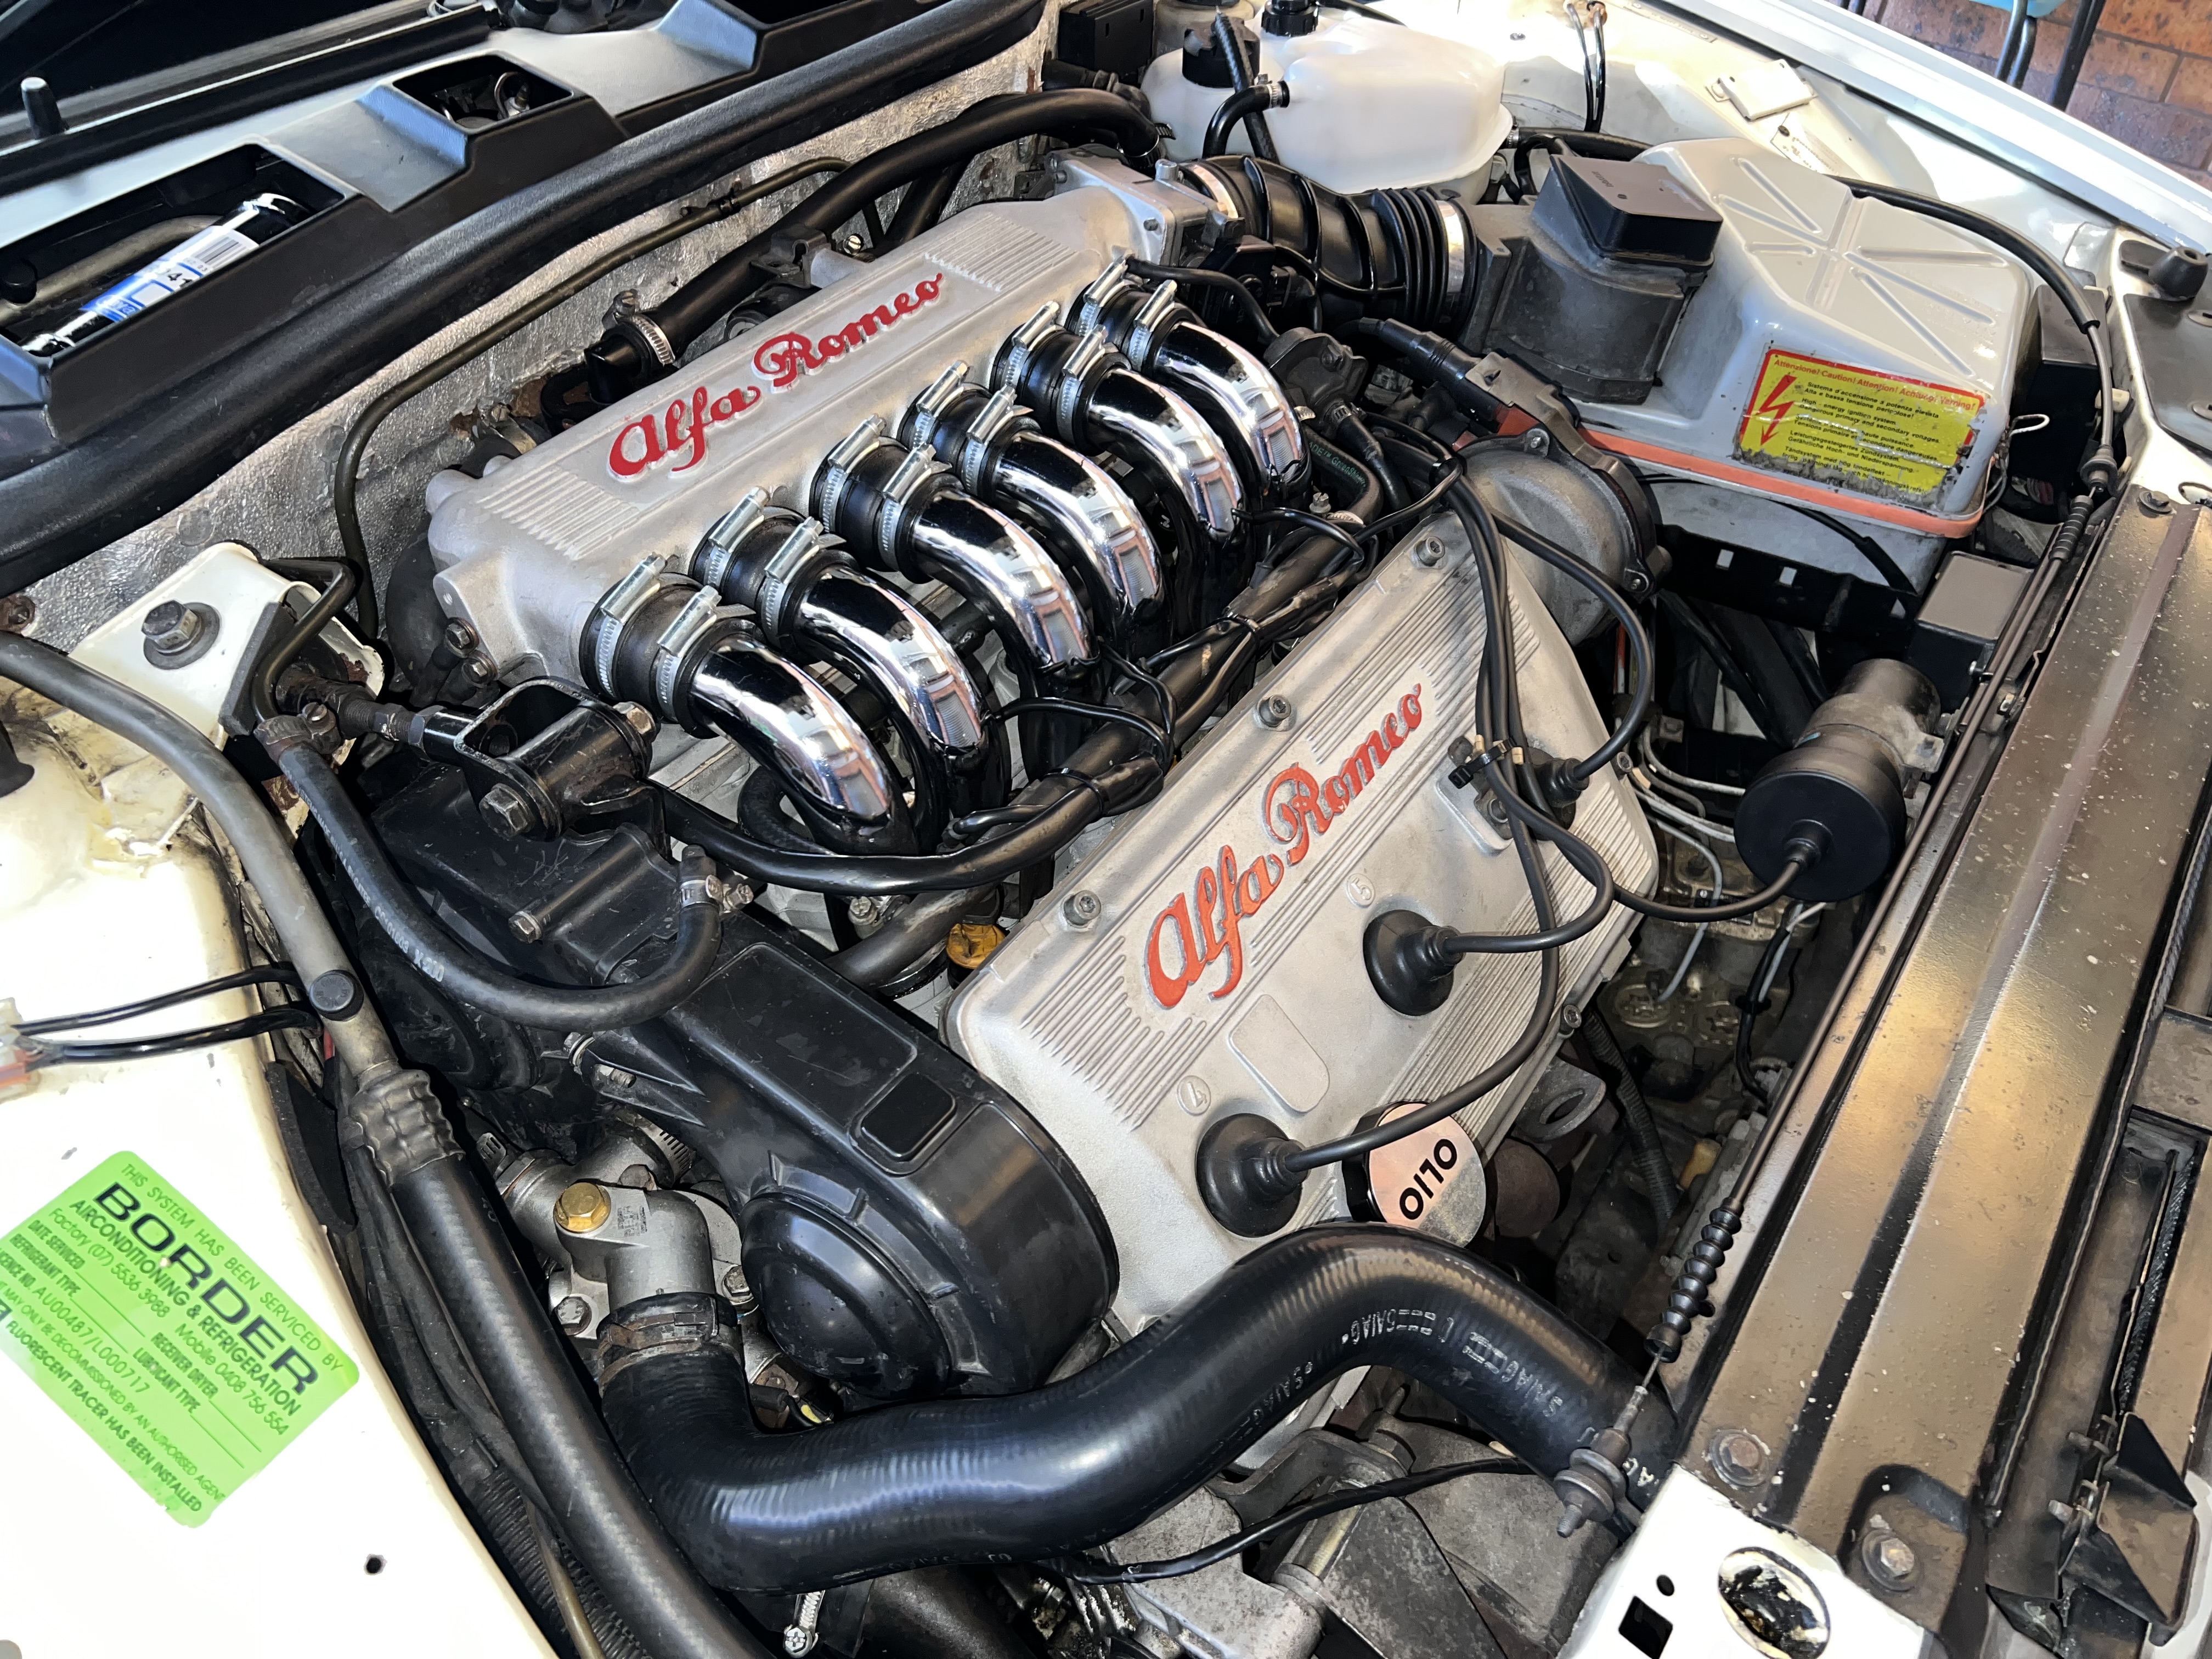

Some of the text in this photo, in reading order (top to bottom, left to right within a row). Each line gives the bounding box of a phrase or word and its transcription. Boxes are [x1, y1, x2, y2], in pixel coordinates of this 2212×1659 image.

[610, 274, 942, 475] Alfa Romeo
[1774, 359, 1820, 375] Attenzione!
[1821, 370, 1856, 383] Caution!
[1856, 378, 1898, 393] Attention!
[1807, 382, 1832, 392] Sistema
[1835, 388, 1878, 402] d'accensione
[1886, 402, 1912, 412] potenza
[1914, 408, 1939, 418] elevata
[1825, 393, 1844, 401] bassa
[1846, 398, 1874, 409] tensione
[1789, 430, 1859, 451] Leistungsgesteigertes
[1794, 420, 1822, 430] Tensions
[1822, 427, 1849, 437] primaire
[1860, 438, 1894, 449] econdaire
[1799, 404, 1833, 416] Dangerous
[1835, 413, 1860, 423] primary
[1876, 424, 1910, 436] secondary
[1911, 433, 1940, 444] voltages.
[1823, 403, 1845, 413] energy
[1847, 409, 1871, 419] ignition
[1860, 430, 1879, 438] haute
[1148, 685, 1422, 1007] Alfa Romeo
[1399, 1138, 1458, 1220] OLIO
[0, 1249, 26, 1279] CENCE
[9, 1233, 81, 1297] REFRIGERANT TYPE
[27, 1220, 85, 1269] DATE SERVICED
[49, 1208, 170, 1317] Factory (07) 5536 3988
[122, 1164, 343, 1370] THIS SYSTEM HAS BEEN SERVICED BY
[69, 1200, 301, 1416] AIRCONDITIONING & REFRIGERATION
[93, 1182, 319, 1394] BORDER
[3, 1288, 24, 1305] MAY
[21, 1305, 48, 1330] ONLY
[41, 1323, 55, 1335] BE
[50, 1333, 126, 1404] DECOMMISSIONED
[122, 1402, 137, 1413] BY
[133, 1414, 150, 1429] AN
[147, 1428, 197, 1475] AUTHORISED
[133, 1347, 200, 1413] LUBRICANT TYPE
[151, 1332, 218, 1398] RECEIVER DRYER
[175, 1323, 289, 1435] Mobile 0408 756 554
[7, 1321, 201, 1511] FLUORESCENT TRACER HAS BEEN INSTALLED
